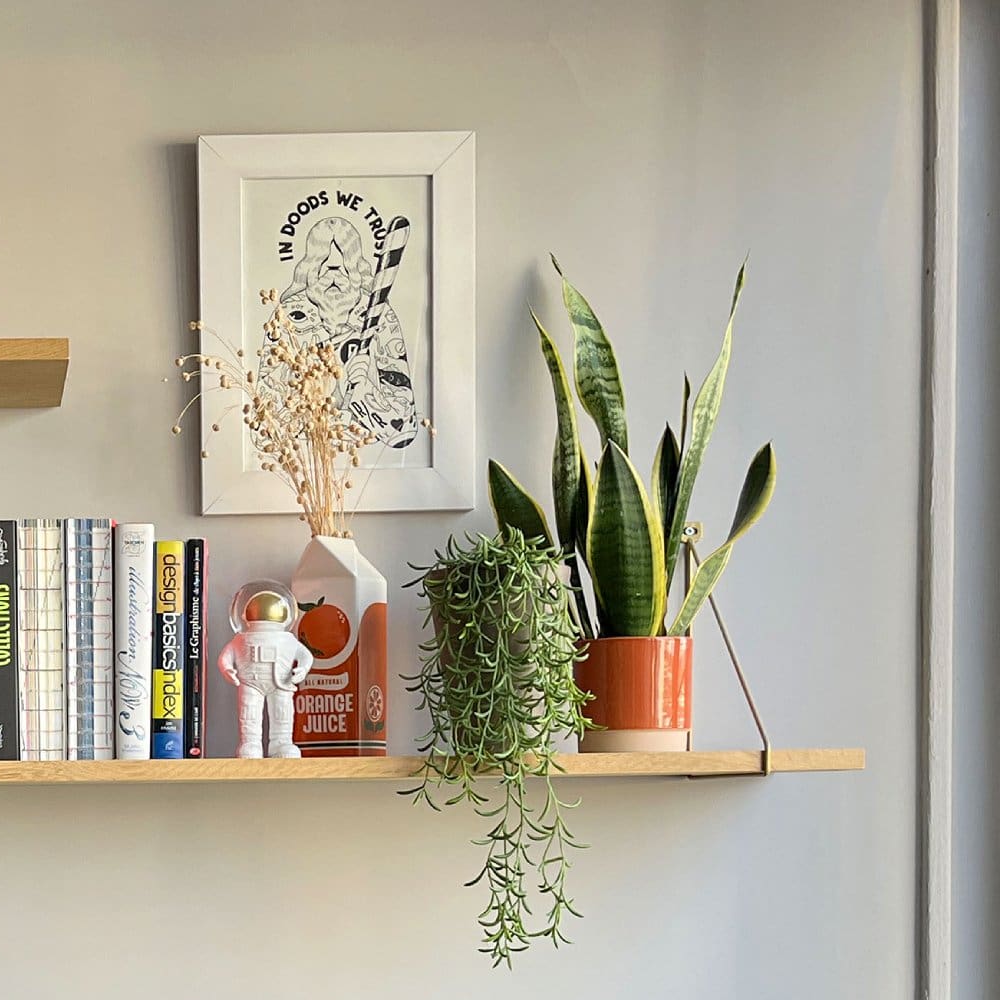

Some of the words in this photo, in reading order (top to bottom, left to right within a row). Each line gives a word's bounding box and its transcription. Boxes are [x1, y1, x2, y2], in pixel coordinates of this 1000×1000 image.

[336, 191, 363, 211] WE
[280, 191, 329, 237] DOODS
[279, 242, 293, 261] IN
[189, 596, 202, 646] Graphisme
[296, 694, 353, 713] ORANGE
[303, 714, 346, 733] JUICE
